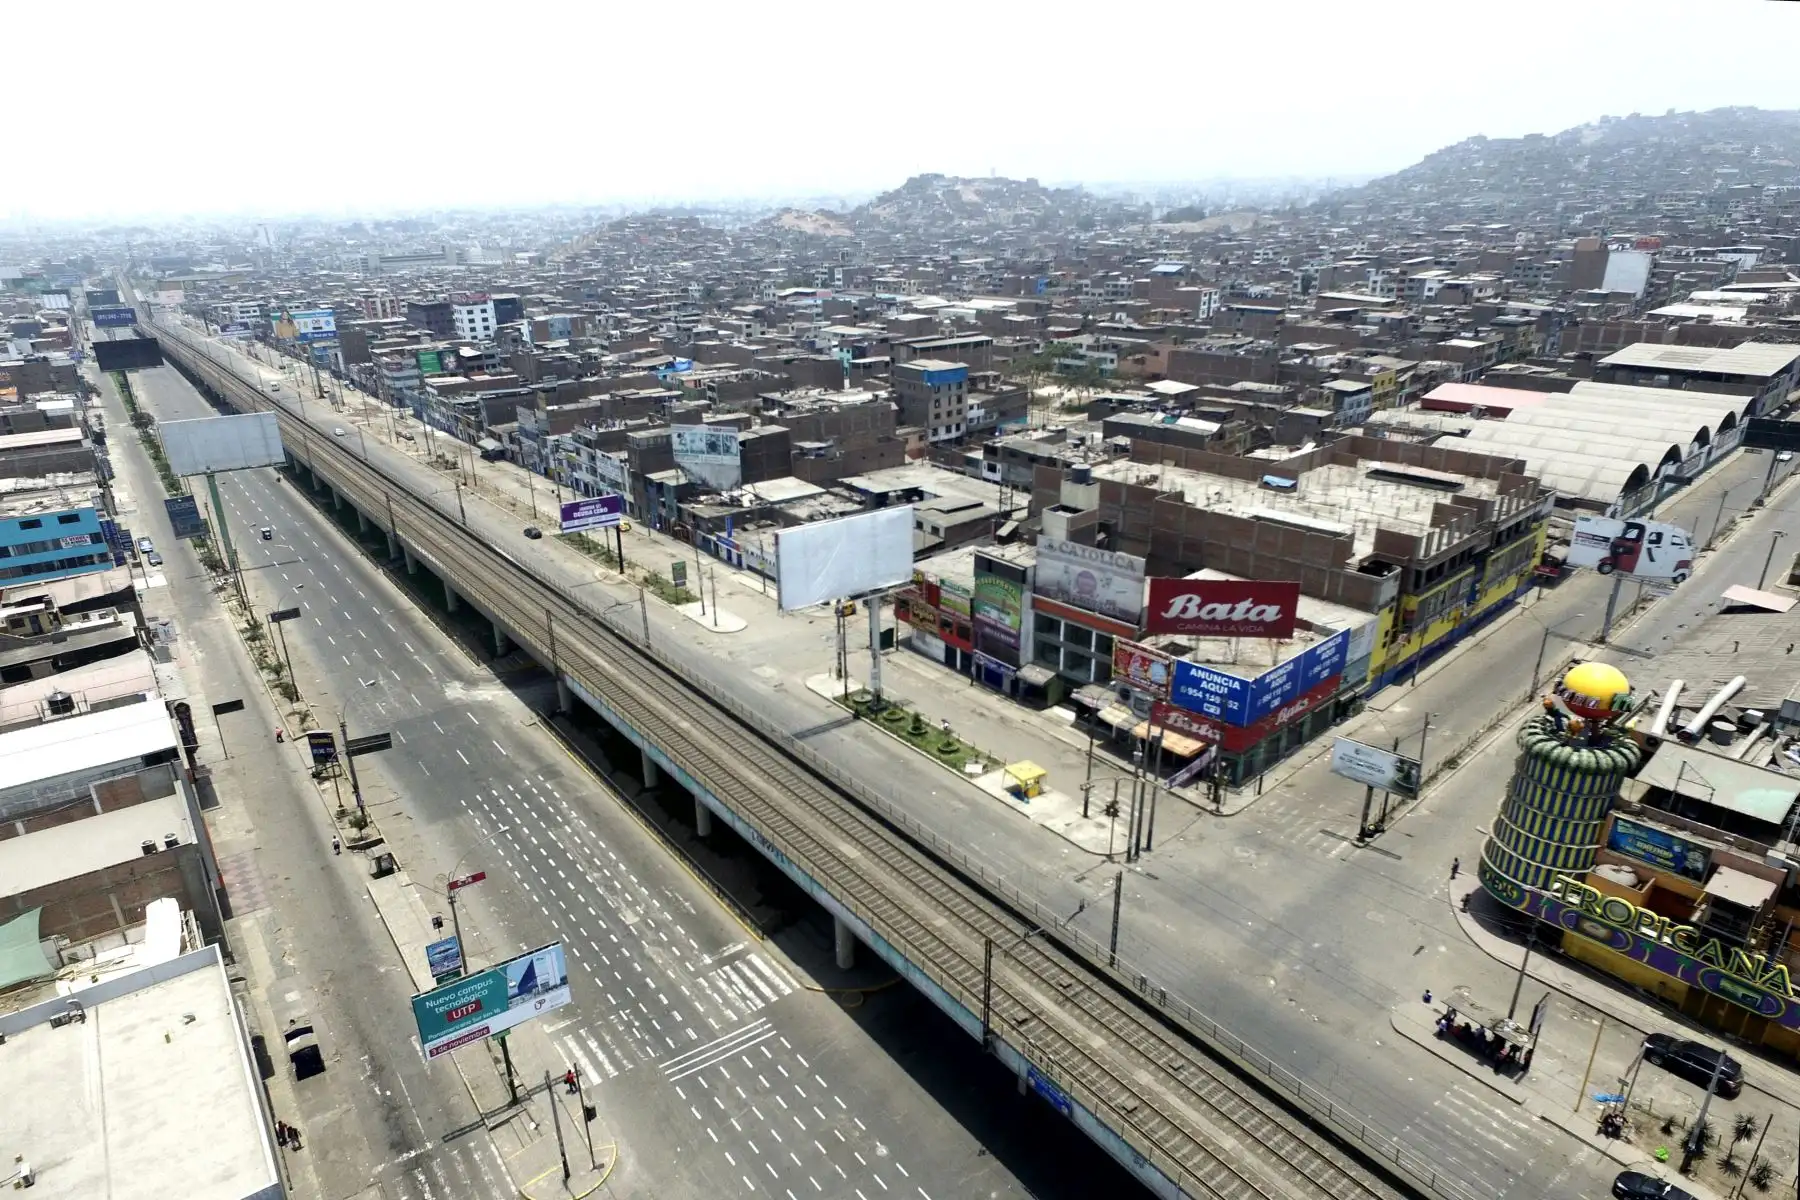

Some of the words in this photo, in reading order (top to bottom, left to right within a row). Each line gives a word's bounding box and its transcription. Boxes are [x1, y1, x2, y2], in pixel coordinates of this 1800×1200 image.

[1160, 593, 1283, 622] Bata
[1176, 623, 1220, 631] CAMINA
[1190, 668, 1241, 690] ANUNCIA
[1200, 680, 1228, 694] AQUI
[1164, 712, 1222, 741] Bata
[1554, 874, 1793, 997] TROPICANA
[425, 993, 456, 1009] Nuevo
[457, 977, 494, 998] campus
[434, 988, 488, 1014] tecnológico
[452, 1004, 477, 1019] UTP
[471, 1015, 482, 1023] Sur
[438, 1045, 448, 1053] de
[449, 1029, 488, 1049] noviembre
